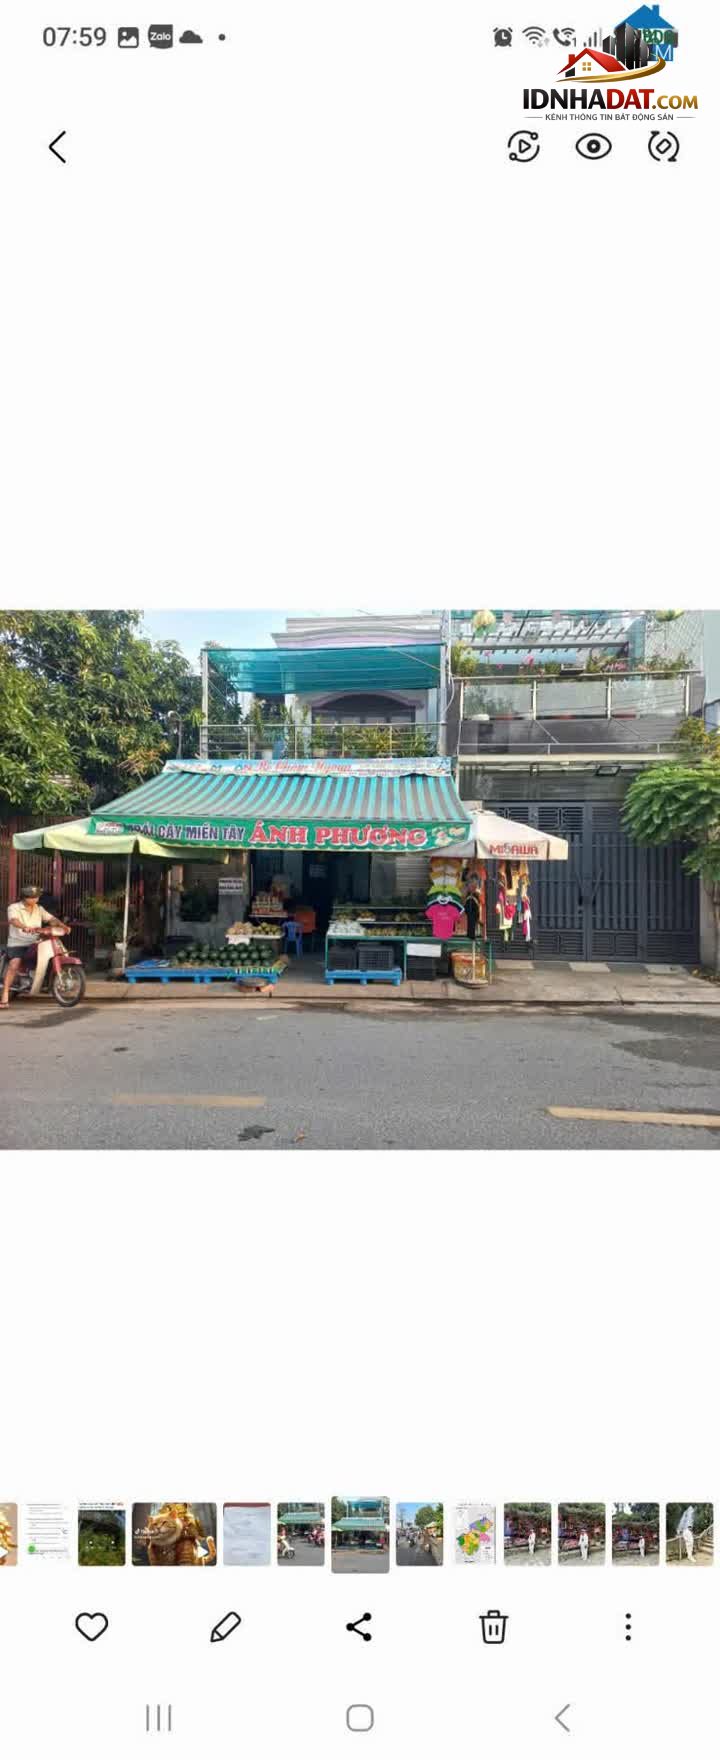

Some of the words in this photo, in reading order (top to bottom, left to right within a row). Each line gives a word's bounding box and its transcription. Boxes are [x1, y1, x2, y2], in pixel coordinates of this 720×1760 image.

[42, 26, 107, 47] 07:59
[150, 31, 171, 41] Zalo
[314, 825, 428, 847] PHƯƠNG
